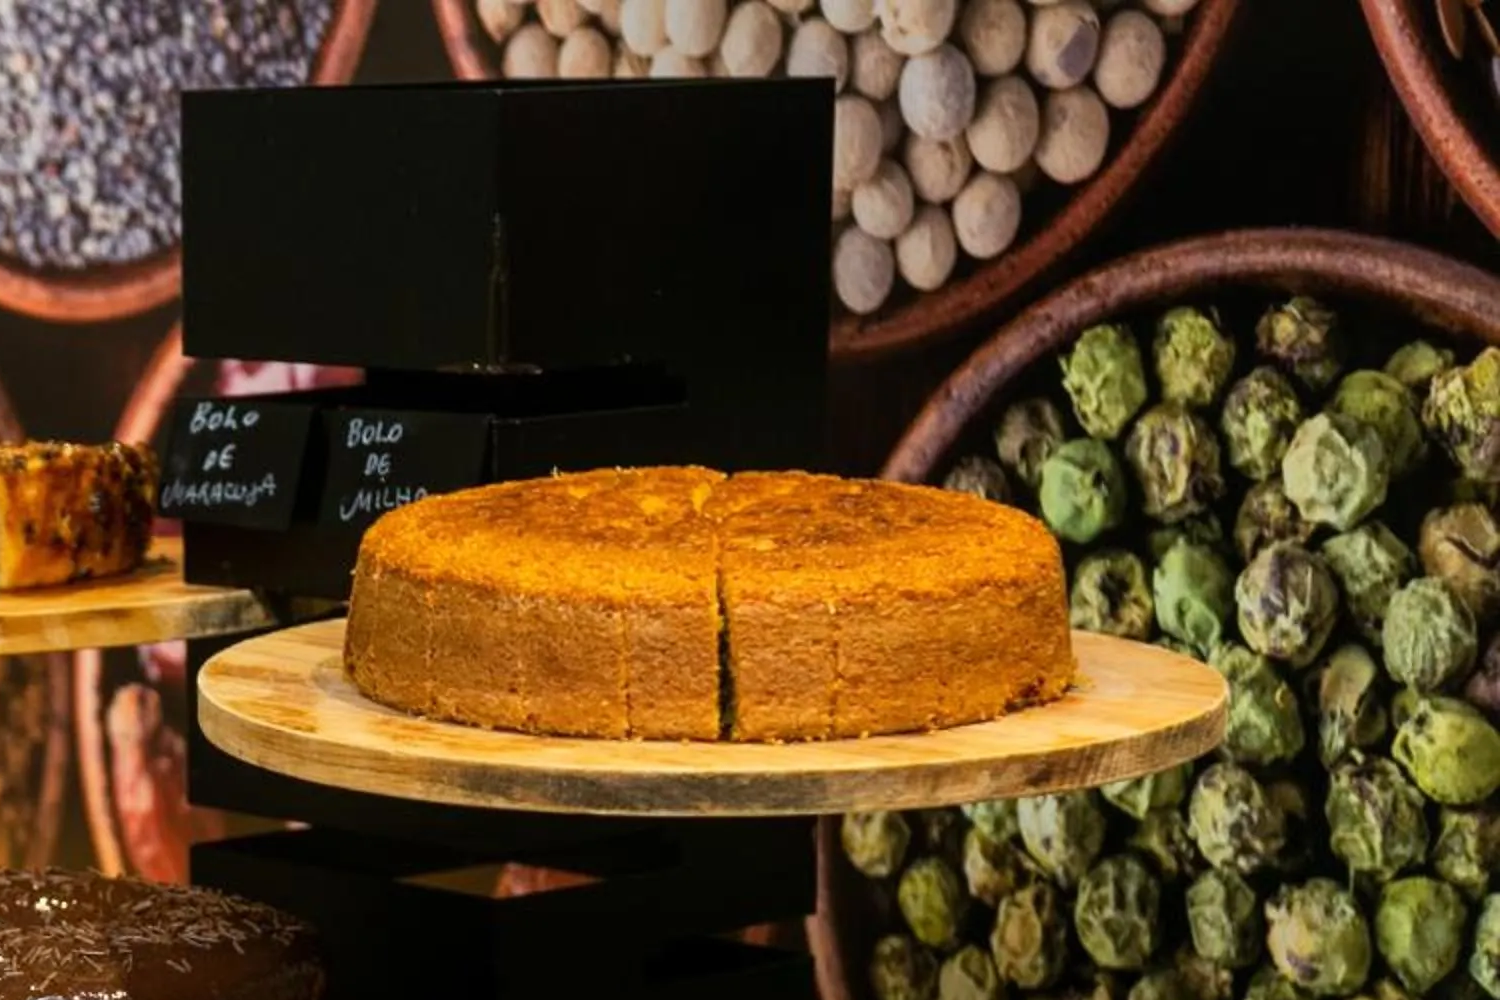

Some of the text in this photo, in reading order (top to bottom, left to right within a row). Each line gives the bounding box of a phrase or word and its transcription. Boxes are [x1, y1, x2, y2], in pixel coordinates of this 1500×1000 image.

[189, 401, 260, 434] BOLO
[347, 417, 403, 448] BOLO
[202, 443, 237, 471] DE
[363, 452, 391, 476] DE
